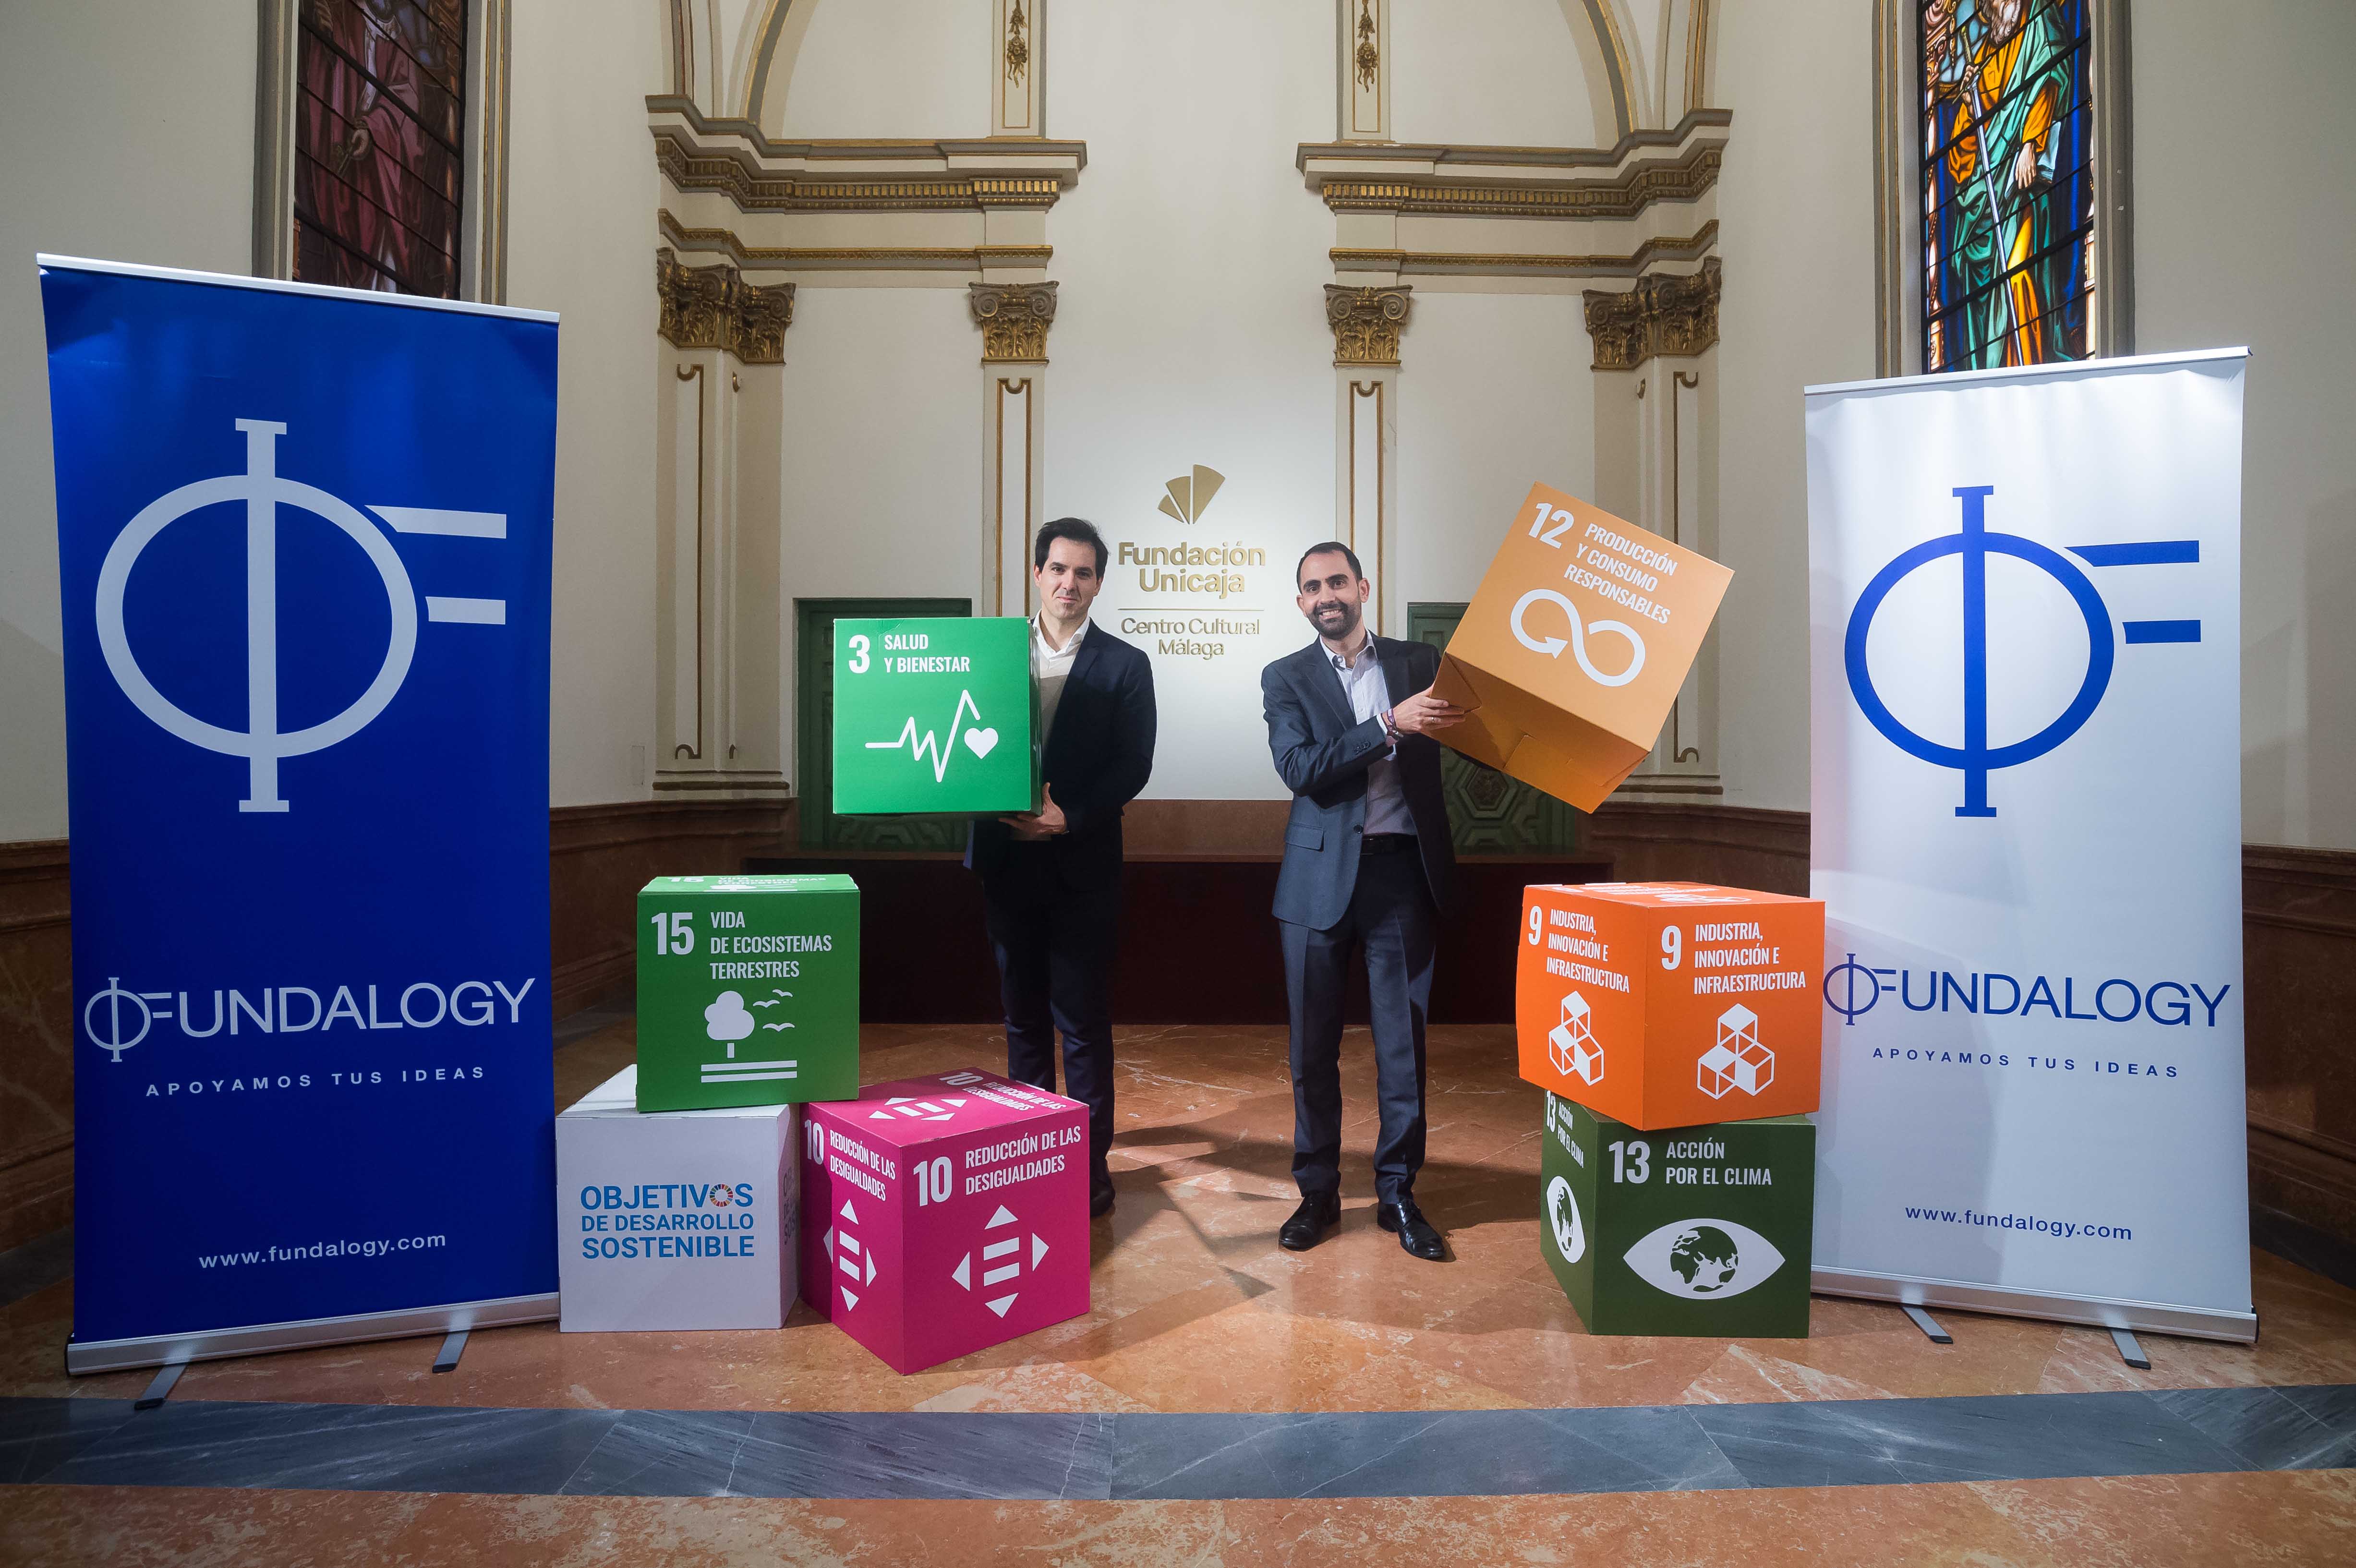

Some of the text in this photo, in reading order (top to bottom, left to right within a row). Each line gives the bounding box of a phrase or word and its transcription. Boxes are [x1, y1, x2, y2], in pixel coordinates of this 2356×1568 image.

[1528, 502, 1574, 549] 12
[1118, 541, 1266, 566] Fundación
[1584, 523, 1678, 576] PRODUCCIÓN
[1576, 543, 1658, 592] Y CONSUMO
[1139, 568, 1244, 599] Unicaja
[1563, 564, 1671, 624] RESPONSABLES
[1121, 617, 1260, 634] Centro Cultural
[848, 634, 870, 674] 3
[884, 634, 929, 650] SALUD
[1158, 639, 1224, 660] Málaga
[884, 656, 970, 673] Y BIENESTAR
[651, 912, 694, 955] 15
[711, 912, 745, 928] VIDA
[1528, 905, 1542, 945] 9
[1550, 908, 1596, 935] INDUSTRIA,
[1695, 922, 1764, 942] INDUSTRIA,
[711, 935, 832, 954] DE ECOSISTEMAS
[1548, 932, 1609, 962] INNOVACIÓN E
[1661, 925, 1681, 970] 9
[1694, 943, 1779, 968] INNOVACIÓN E
[710, 961, 799, 979] TERRESTRES
[1546, 956, 1630, 993] INFRAESTRUCTURA
[1694, 971, 1806, 994] INFRAESTRUCTURA
[1873, 1048, 2178, 1077] APOYAMOS TUS IDEAS
[145, 1066, 484, 1097] APOYAMOS TUS IDEAS
[939, 1072, 983, 1086] 10
[962, 1086, 1034, 1110] DESIGUALDADES
[1547, 1090, 1556, 1132] 13
[1559, 1102, 1573, 1130] ACCIÓN
[805, 1119, 824, 1165] 10
[830, 1130, 895, 1180] REDUCCIÓN DE LAS
[966, 1125, 1081, 1169] REDUCCIÓN DE LAS
[1558, 1124, 1584, 1168] POR EL CLIMA
[1666, 1137, 1725, 1159] ACCIÓN
[966, 1155, 1064, 1195] DESIGUALDADES
[1608, 1140, 1650, 1183] 13
[1666, 1167, 1772, 1185] POR EL CLIMA
[830, 1155, 886, 1201] DESIGUALDADES
[913, 1157, 952, 1206] 10
[582, 1213, 753, 1231] DE DESARROLLO
[1905, 1207, 2132, 1240] www.fundalogy.com
[199, 1235, 446, 1268] www.fundalogy.com
[582, 1235, 754, 1259] SOSTENIBLE
